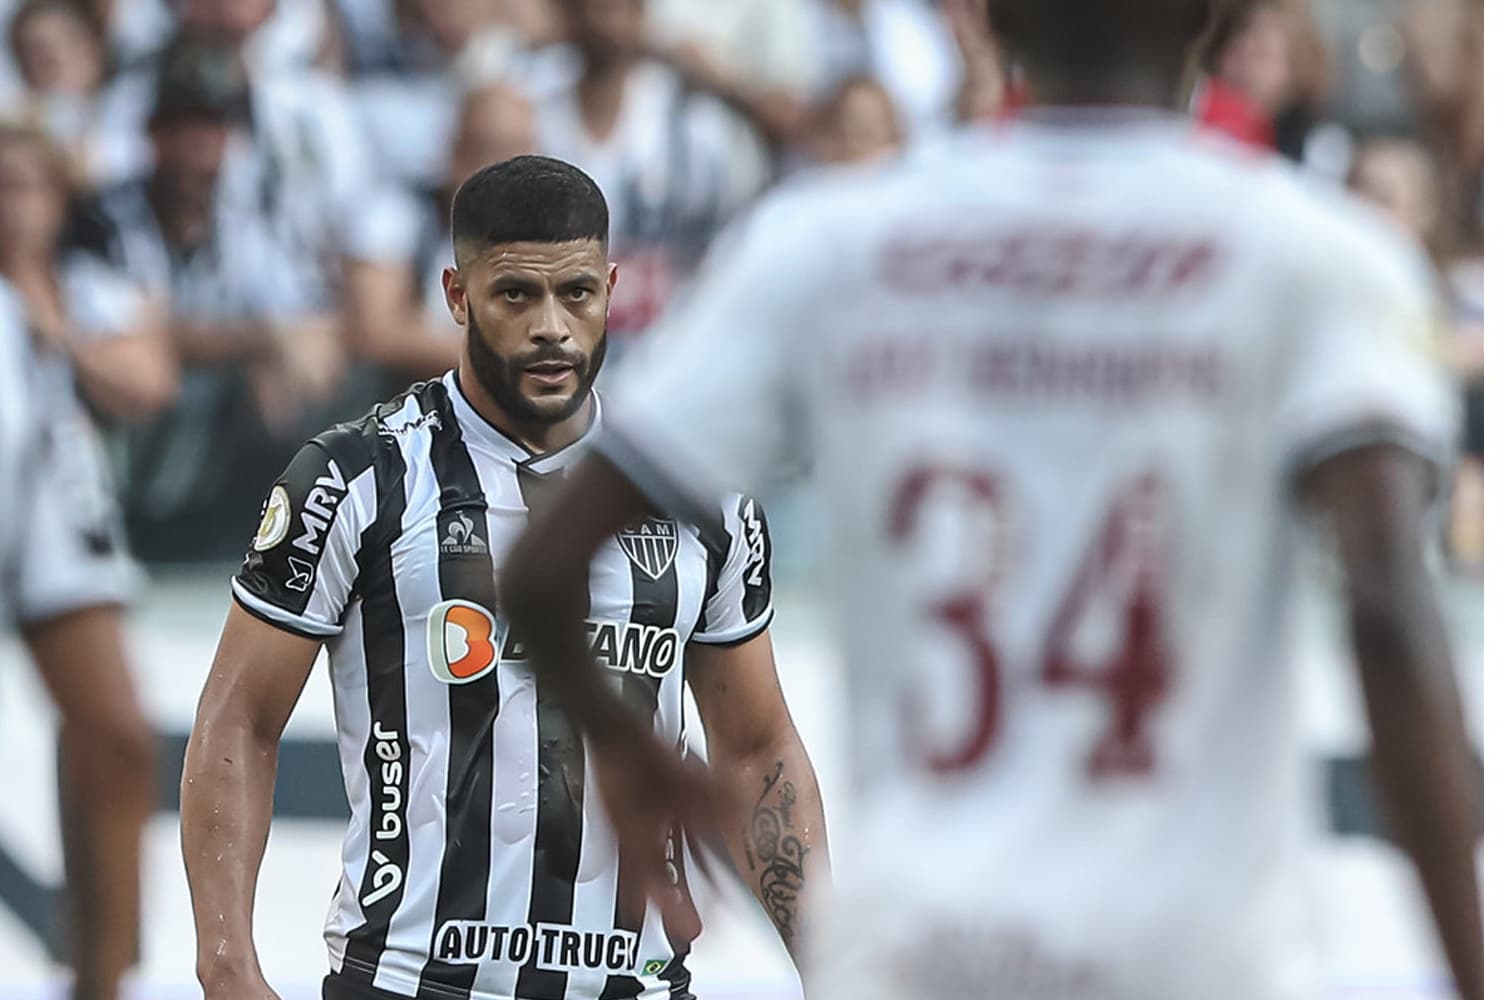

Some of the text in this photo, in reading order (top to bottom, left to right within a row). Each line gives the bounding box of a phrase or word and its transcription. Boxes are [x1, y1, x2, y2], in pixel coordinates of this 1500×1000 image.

[292, 459, 347, 554] MRV
[888, 455, 1176, 782] 34
[374, 721, 402, 839] buser
[439, 926, 528, 962] AUTO
